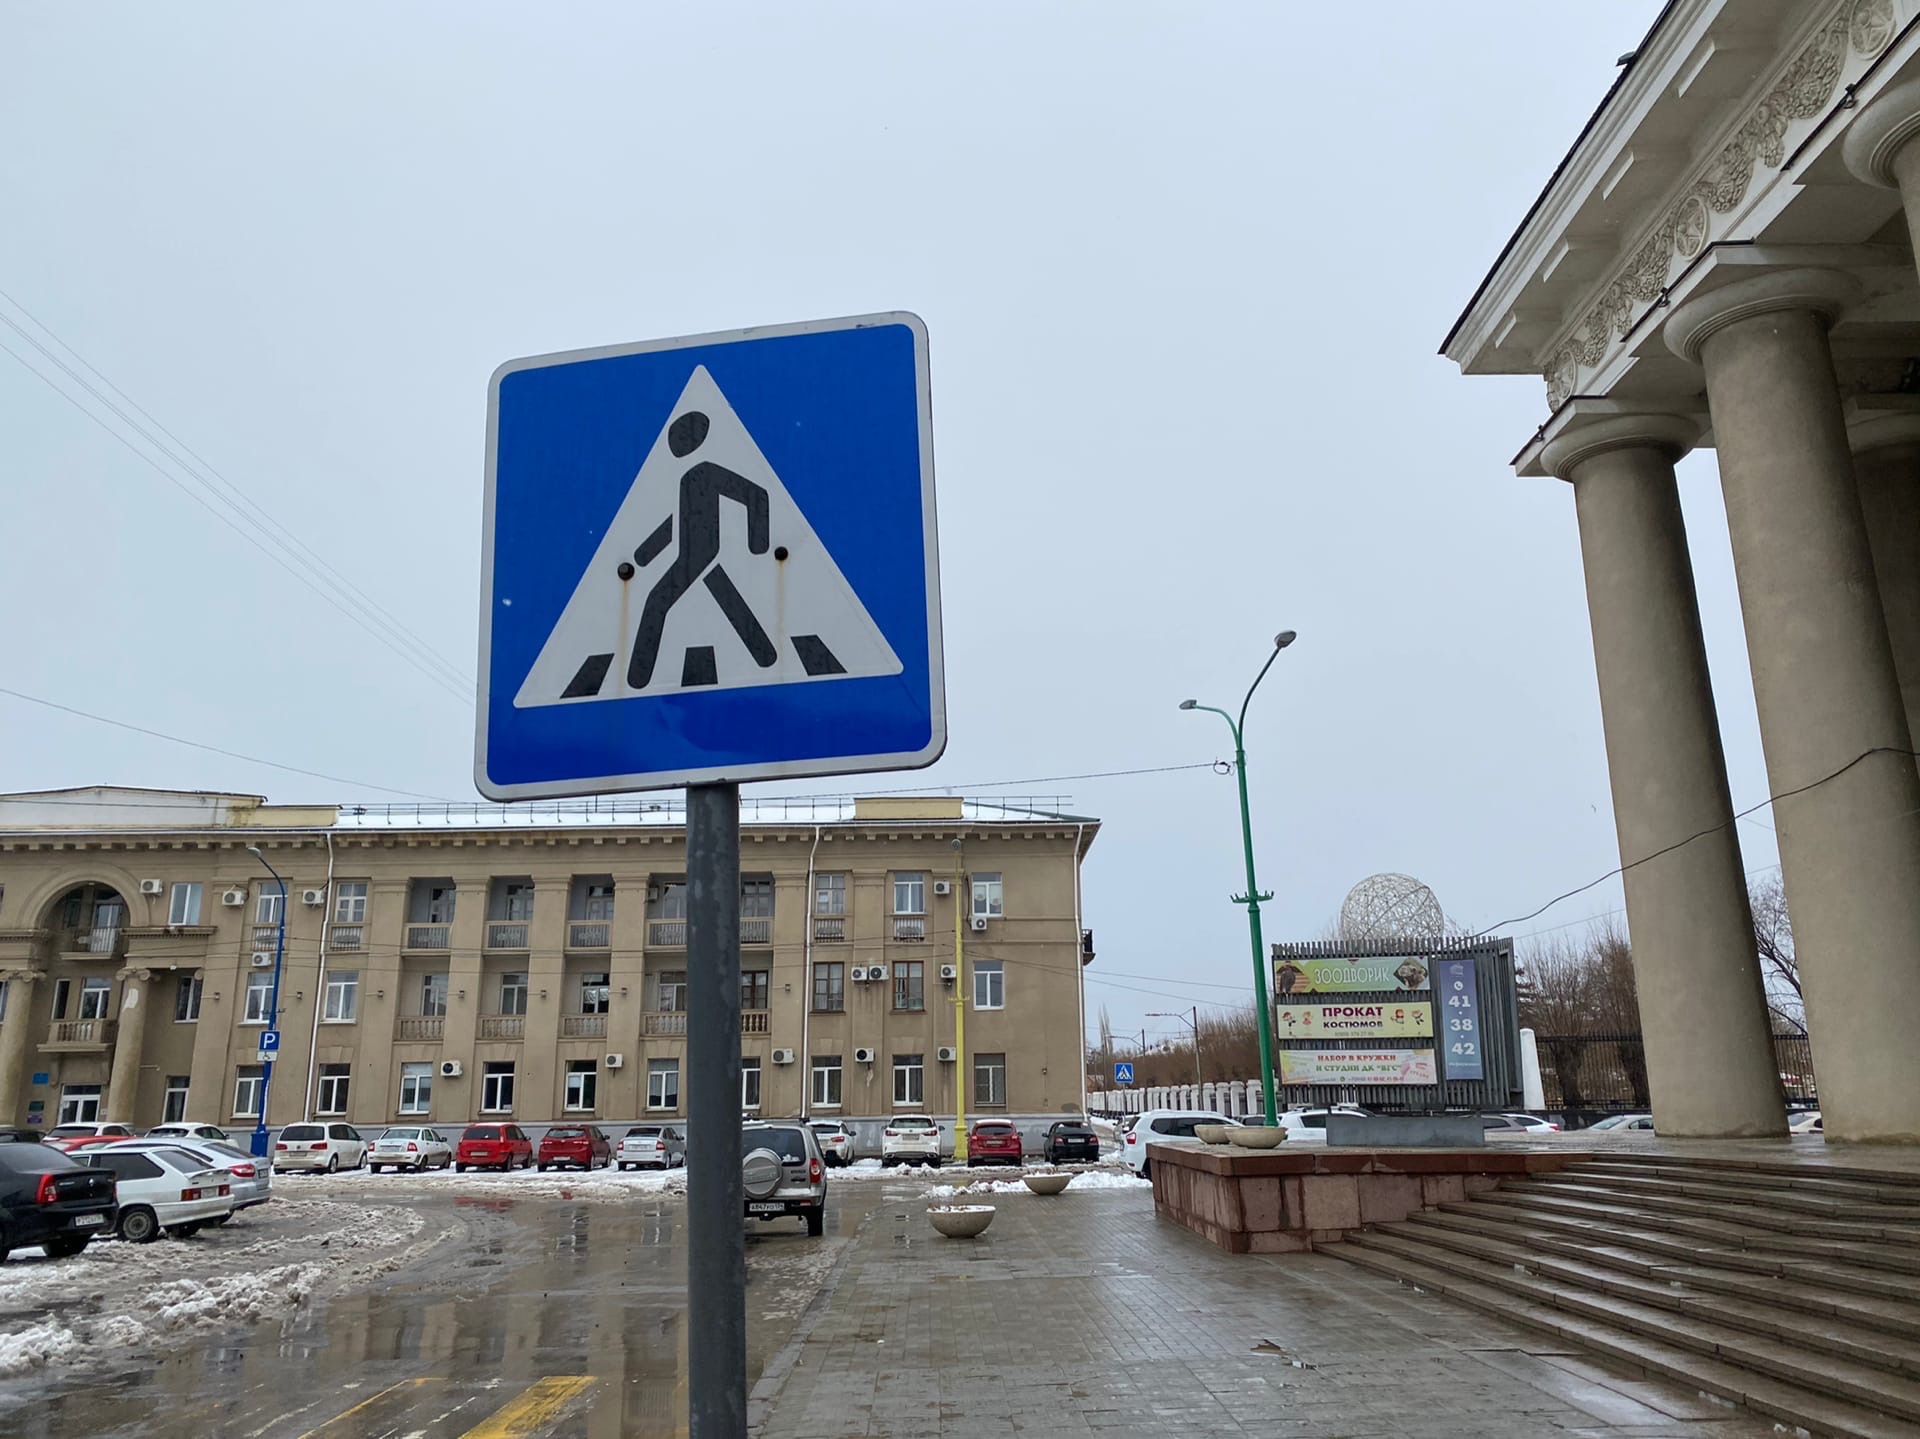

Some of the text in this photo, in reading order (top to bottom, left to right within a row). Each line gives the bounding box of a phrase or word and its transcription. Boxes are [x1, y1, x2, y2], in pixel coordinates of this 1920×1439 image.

[1314, 967, 1390, 984] ЗООДВОРИК
[1448, 995, 1471, 1008] 41
[1322, 1007, 1383, 1017] ПРОКАТ
[1450, 1018, 1473, 1031] 38
[263, 1033, 275, 1048] P
[1451, 1042, 1475, 1055] 42
